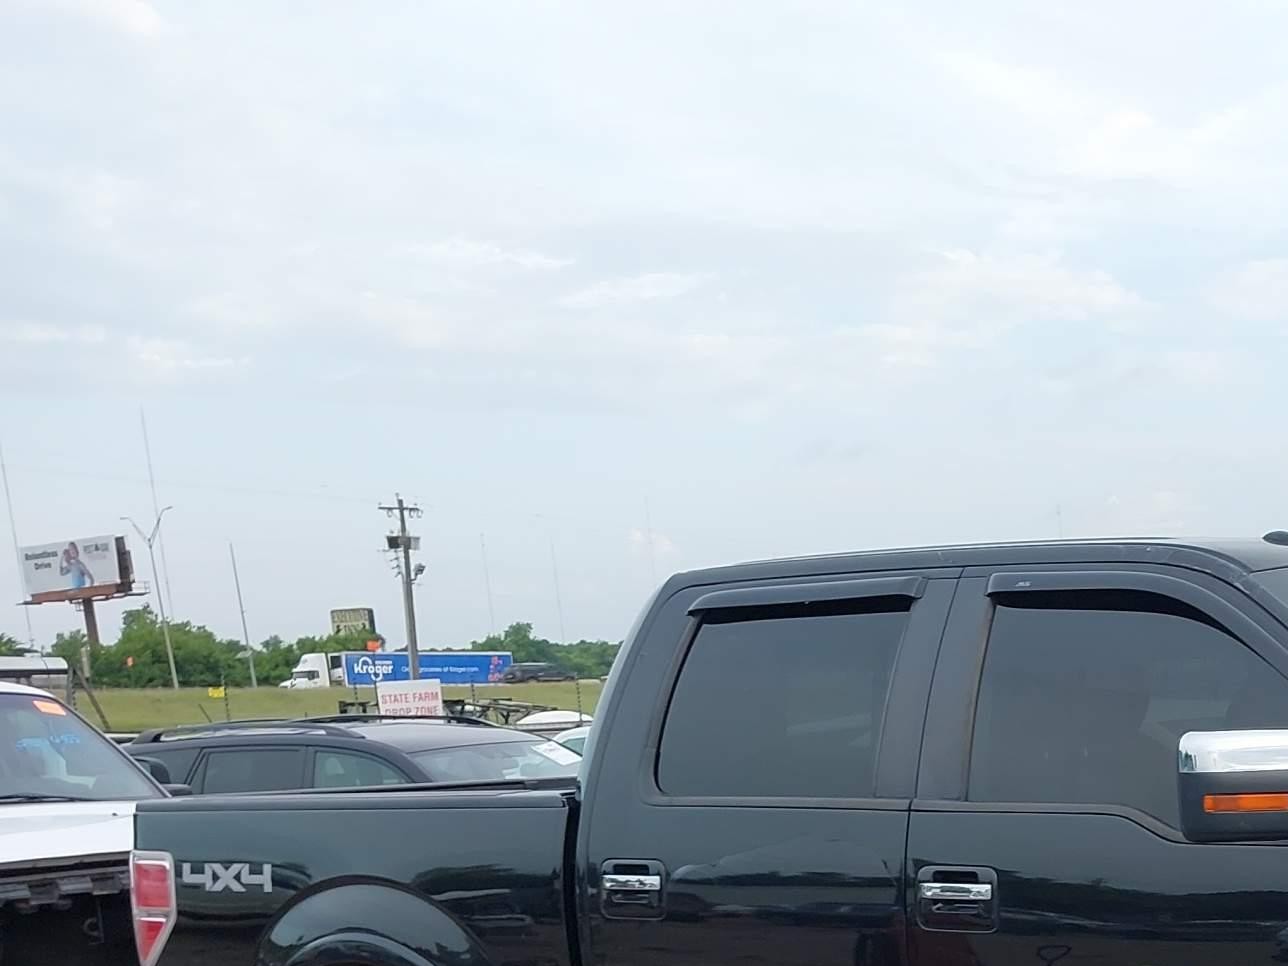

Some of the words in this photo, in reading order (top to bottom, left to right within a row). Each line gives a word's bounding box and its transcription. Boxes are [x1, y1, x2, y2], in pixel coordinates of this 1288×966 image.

[354, 657, 393, 681] Kroger
[381, 693, 410, 705] STATE
[412, 691, 439, 703] FARM
